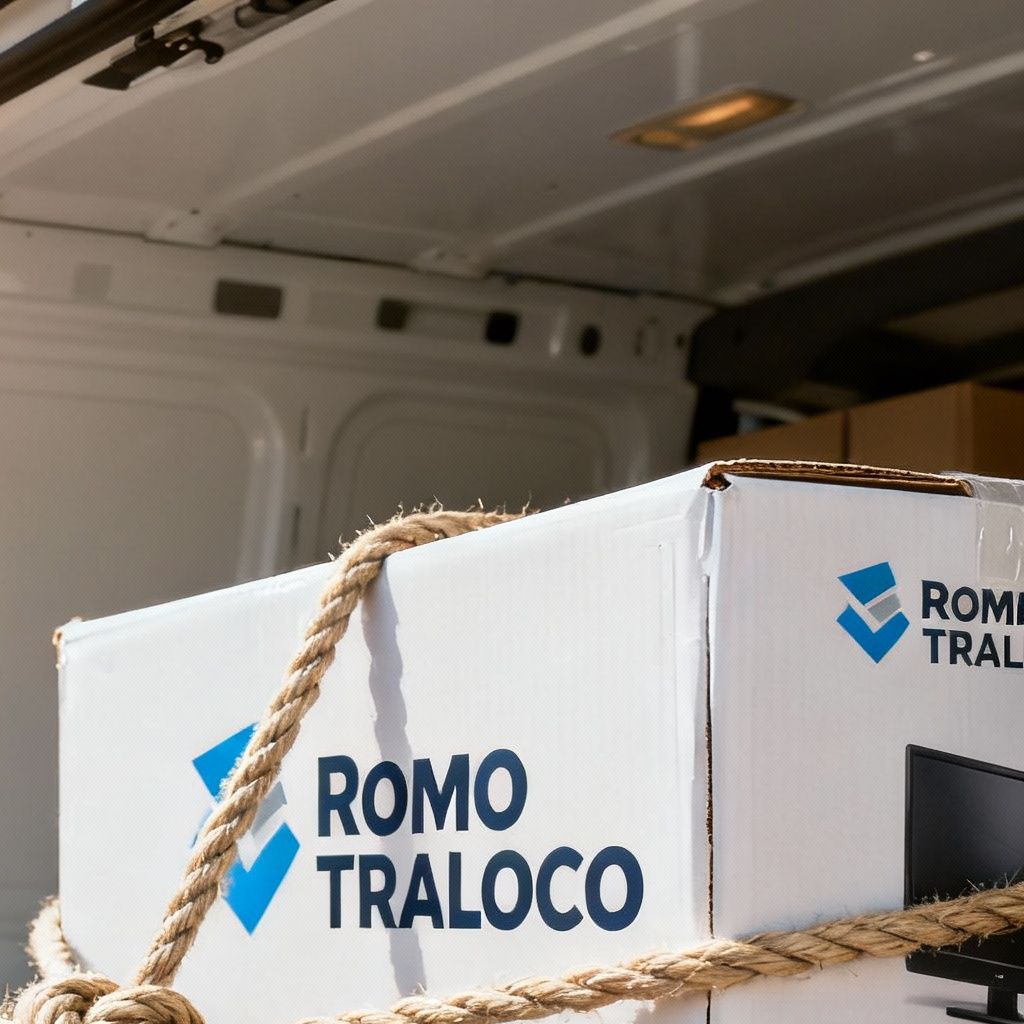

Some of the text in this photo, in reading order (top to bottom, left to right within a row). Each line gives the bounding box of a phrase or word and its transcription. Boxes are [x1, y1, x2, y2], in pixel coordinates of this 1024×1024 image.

[921, 580, 1024, 626] ROM
[922, 628, 1024, 669] TRAL
[317, 748, 528, 837] ROMO
[316, 845, 644, 932] TRALOCO
